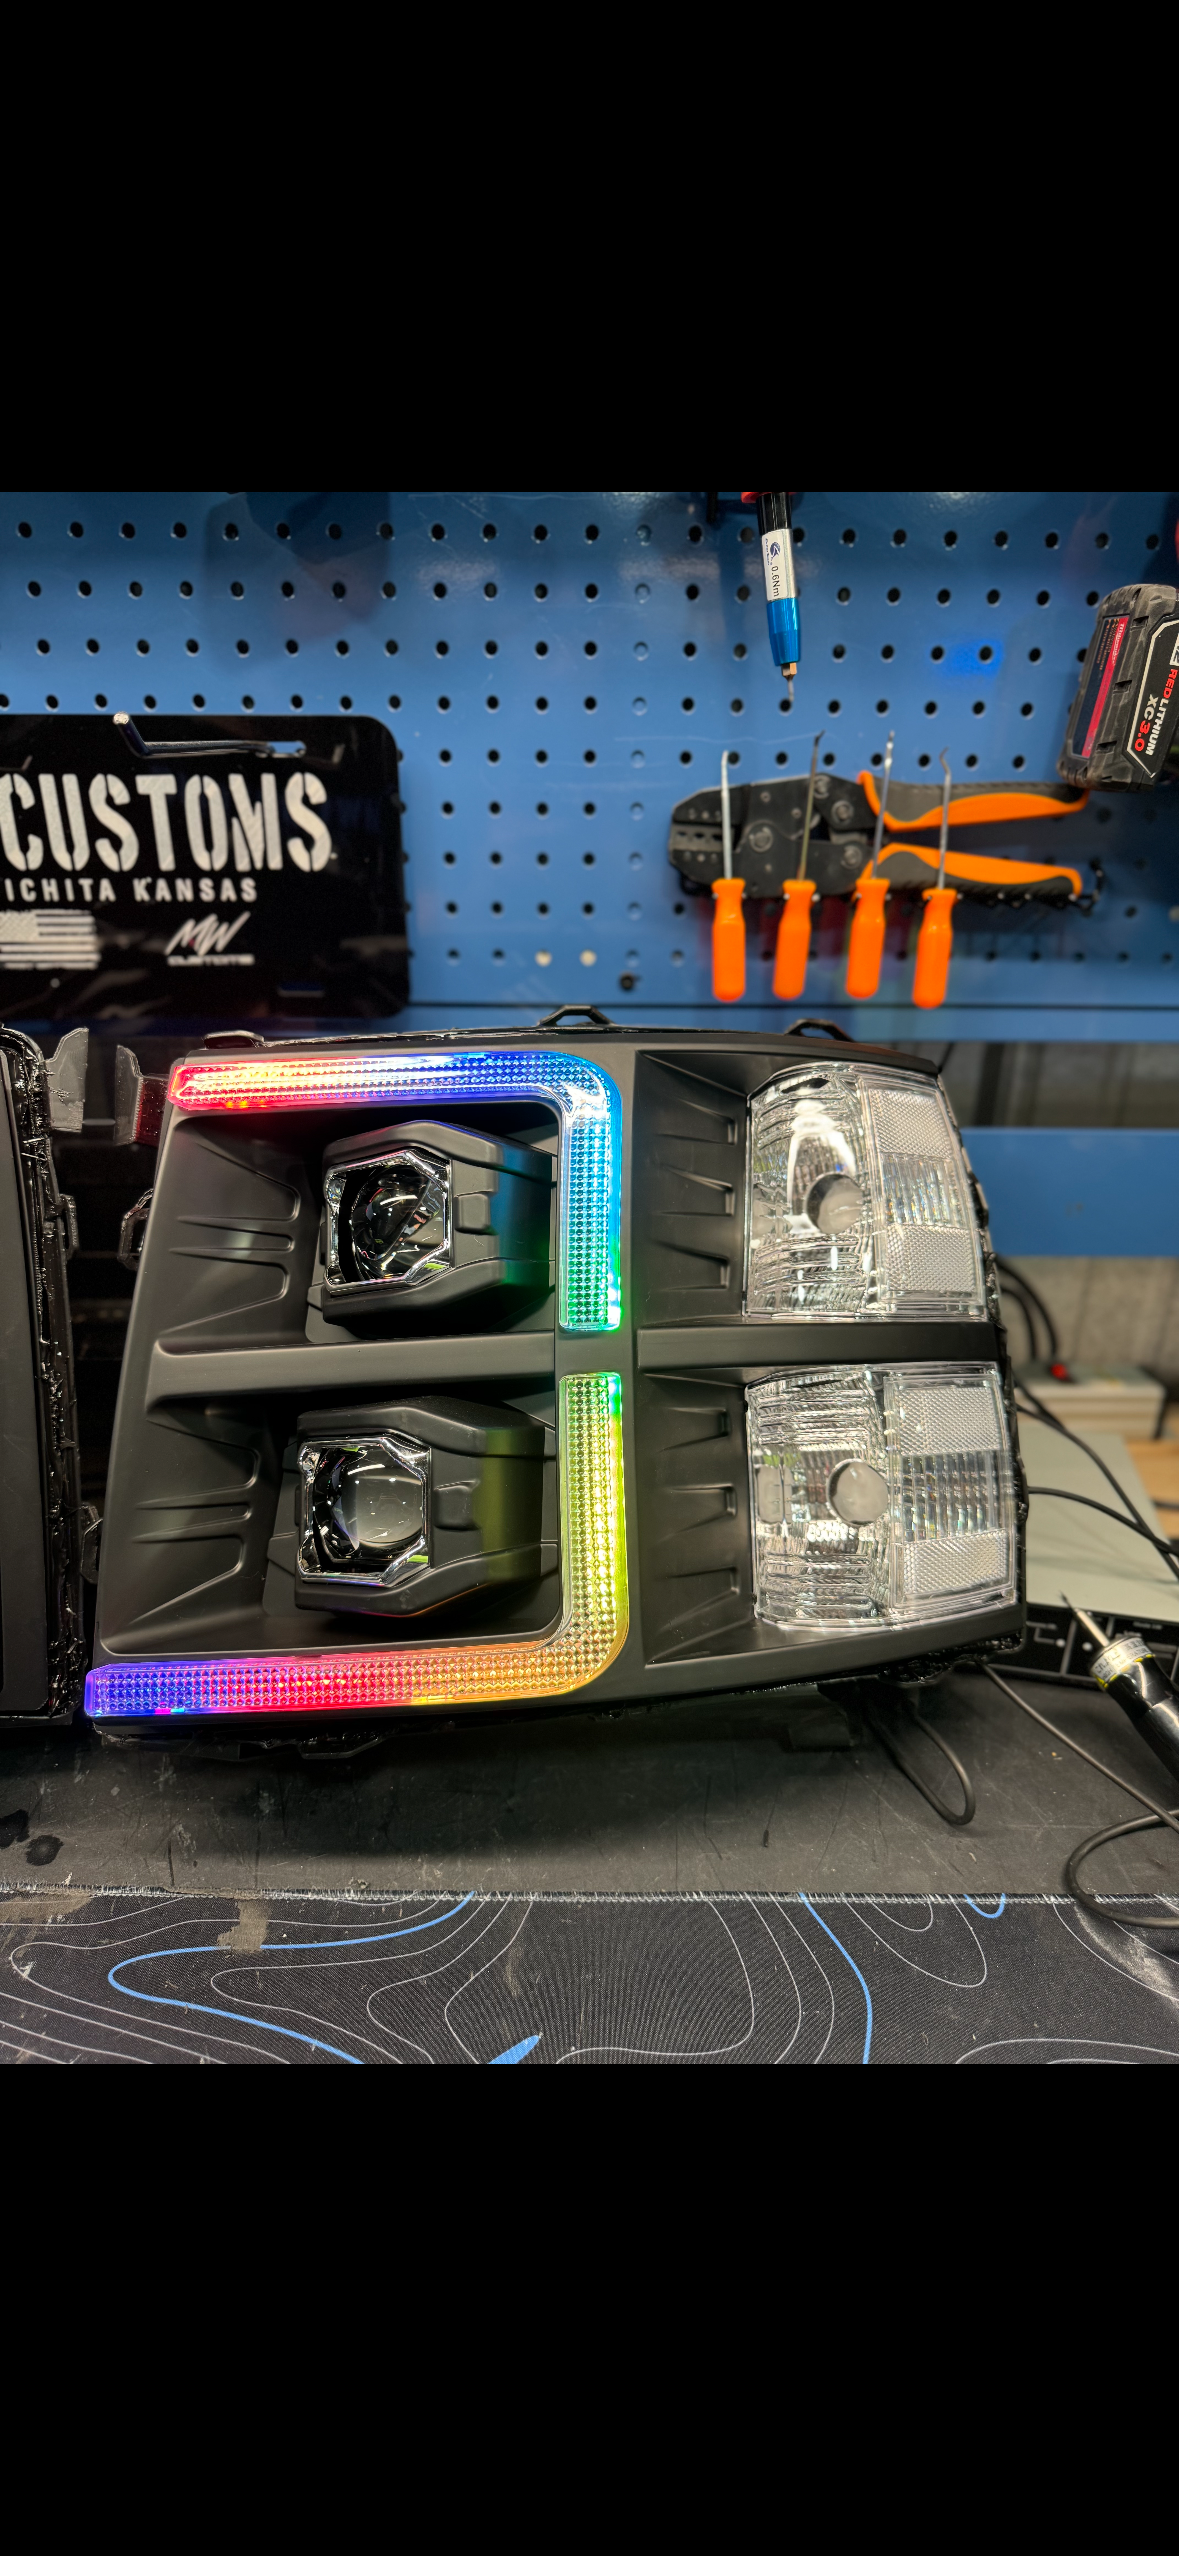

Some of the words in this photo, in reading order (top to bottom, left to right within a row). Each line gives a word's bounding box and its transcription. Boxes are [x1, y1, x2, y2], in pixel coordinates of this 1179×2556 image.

[771, 566, 781, 597] 0.6Nm
[1134, 694, 1159, 752] XC3.0
[1145, 668, 1179, 756] REDLITHIUM
[0, 772, 332, 872] CUSTOMS
[133, 877, 257, 902] KANSAS
